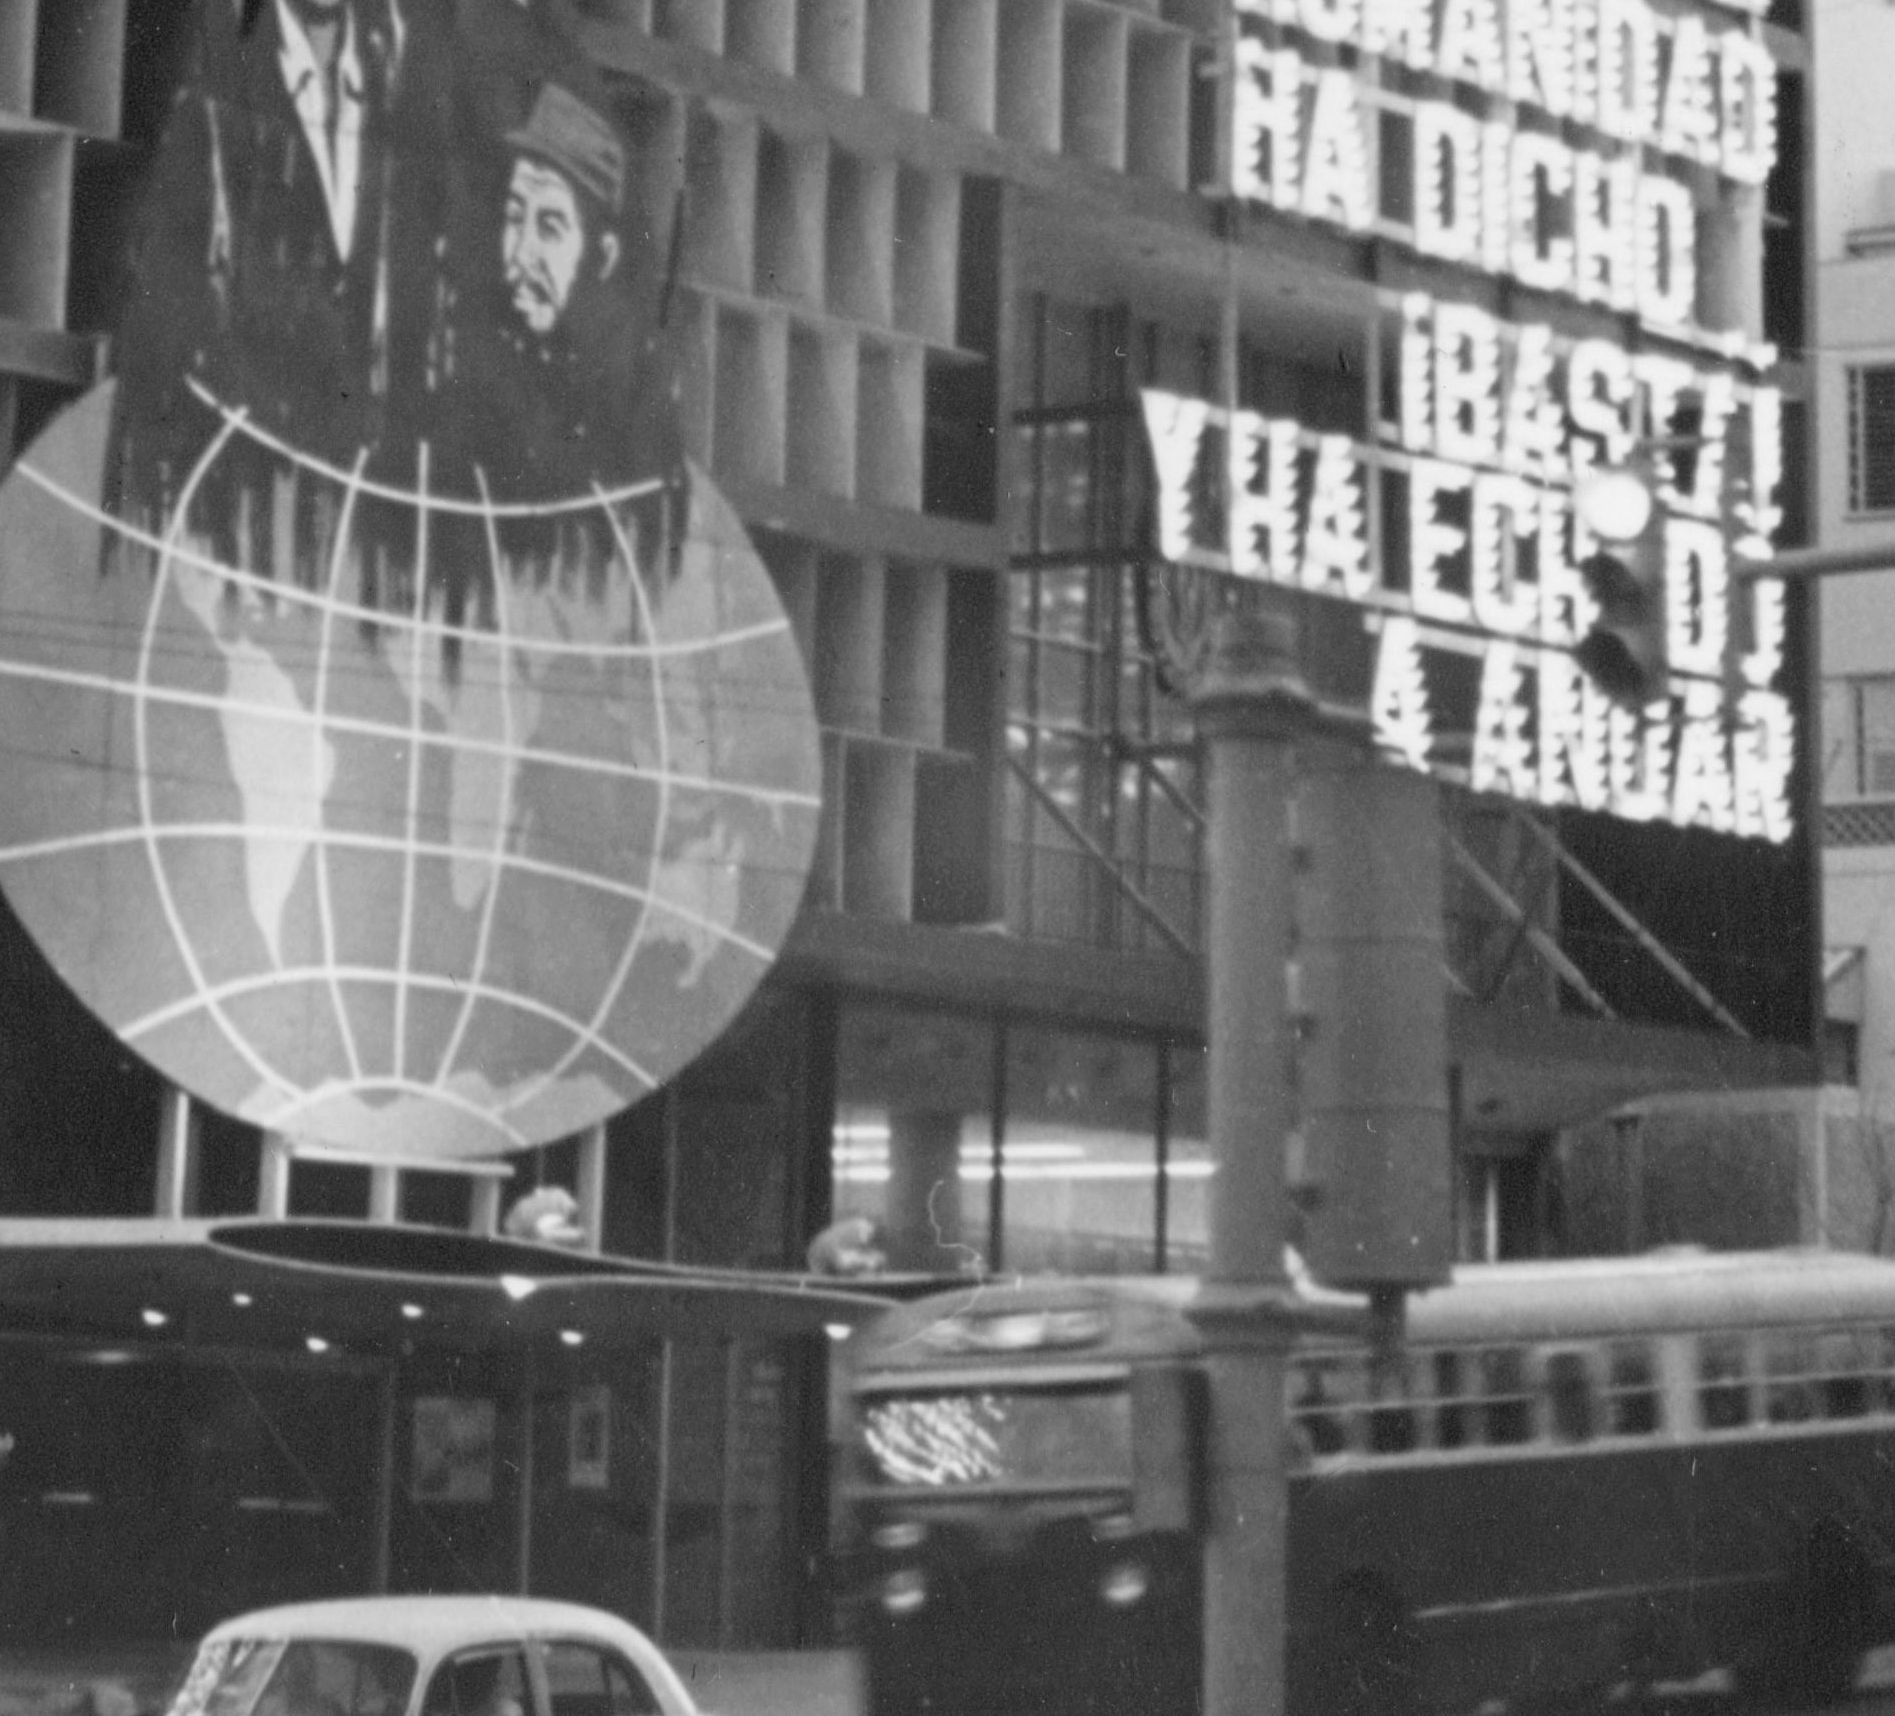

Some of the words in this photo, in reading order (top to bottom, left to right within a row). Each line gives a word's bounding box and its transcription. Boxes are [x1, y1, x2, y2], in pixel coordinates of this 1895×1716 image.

[1233, 36, 1375, 231] HA
[1413, 101, 1697, 324] DICHO
[1228, 409, 1373, 599] HA
[1410, 459, 1786, 686] ECHDO
[1371, 616, 1434, 773] A
